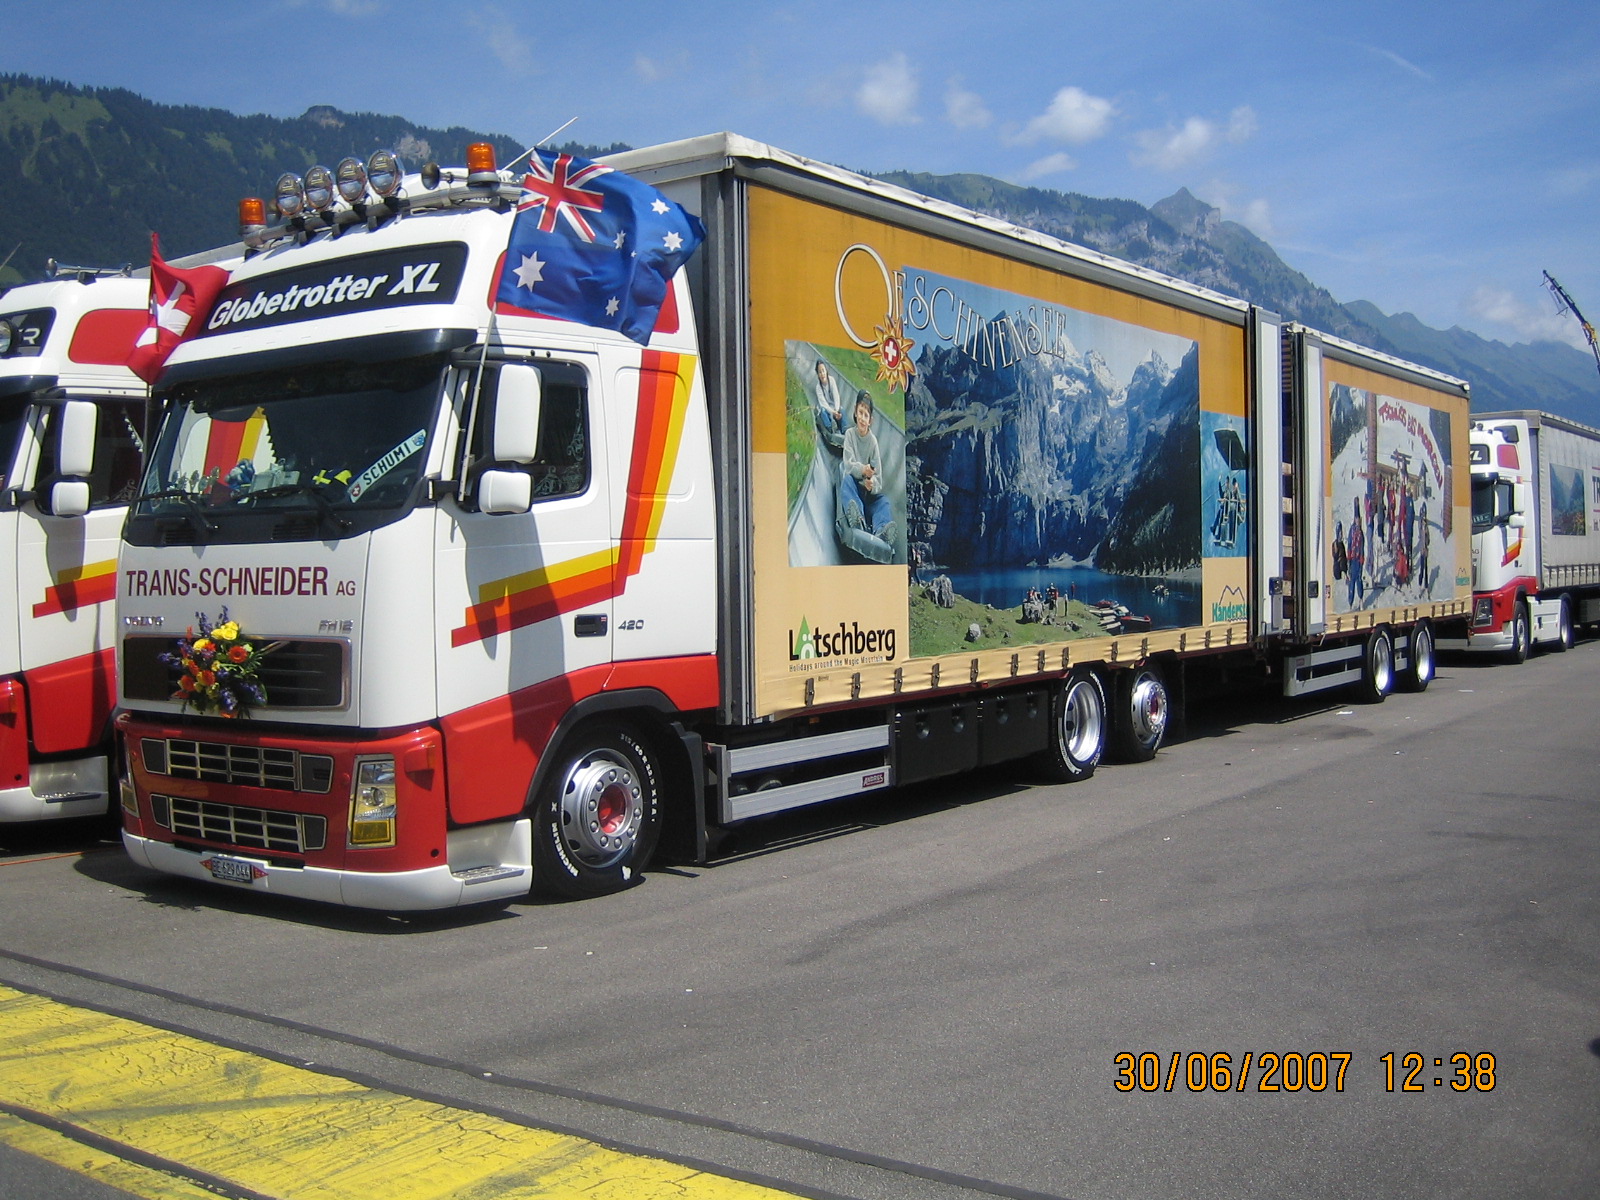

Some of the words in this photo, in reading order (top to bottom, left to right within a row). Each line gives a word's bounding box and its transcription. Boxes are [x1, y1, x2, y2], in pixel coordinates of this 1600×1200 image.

[207, 274, 389, 330] Globetrotter
[387, 262, 441, 296] XL
[363, 442, 411, 486] SCHUMI
[126, 566, 329, 597] TRANS-SCHNEIDER
[335, 580, 356, 597] AG
[618, 619, 644, 631] 420
[788, 621, 895, 661] Lötschberg
[789, 662, 813, 672] Holidays
[814, 659, 833, 669] around
[834, 658, 843, 666] the
[844, 656, 860, 666] Magic
[860, 654, 883, 663] Mountain
[551, 822, 580, 877] MICHELIN
